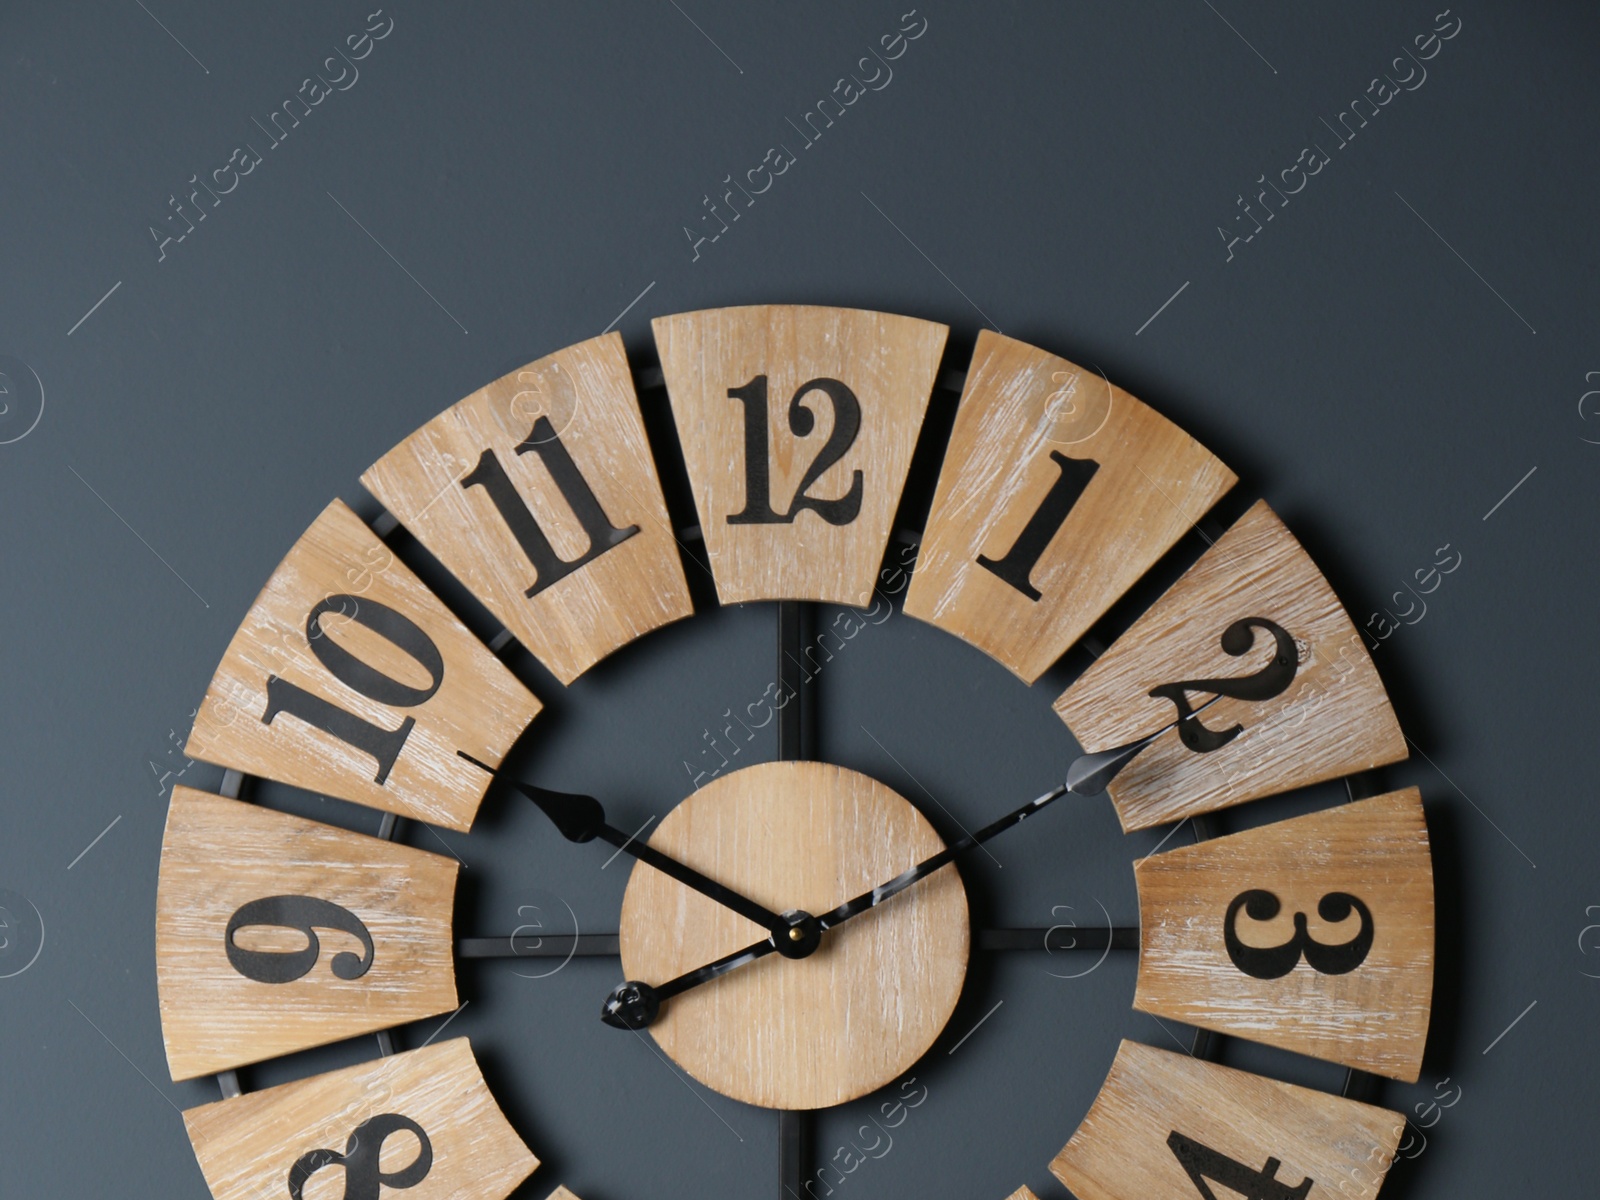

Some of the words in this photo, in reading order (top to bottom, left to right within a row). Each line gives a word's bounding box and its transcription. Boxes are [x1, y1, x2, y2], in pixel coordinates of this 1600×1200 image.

[461, 416, 641, 599] 11
[727, 375, 863, 525] 12
[976, 450, 1100, 602] 1
[262, 594, 444, 785] 10
[1148, 617, 1300, 753] 2
[225, 895, 374, 983] 9
[1224, 889, 1374, 980] 3
